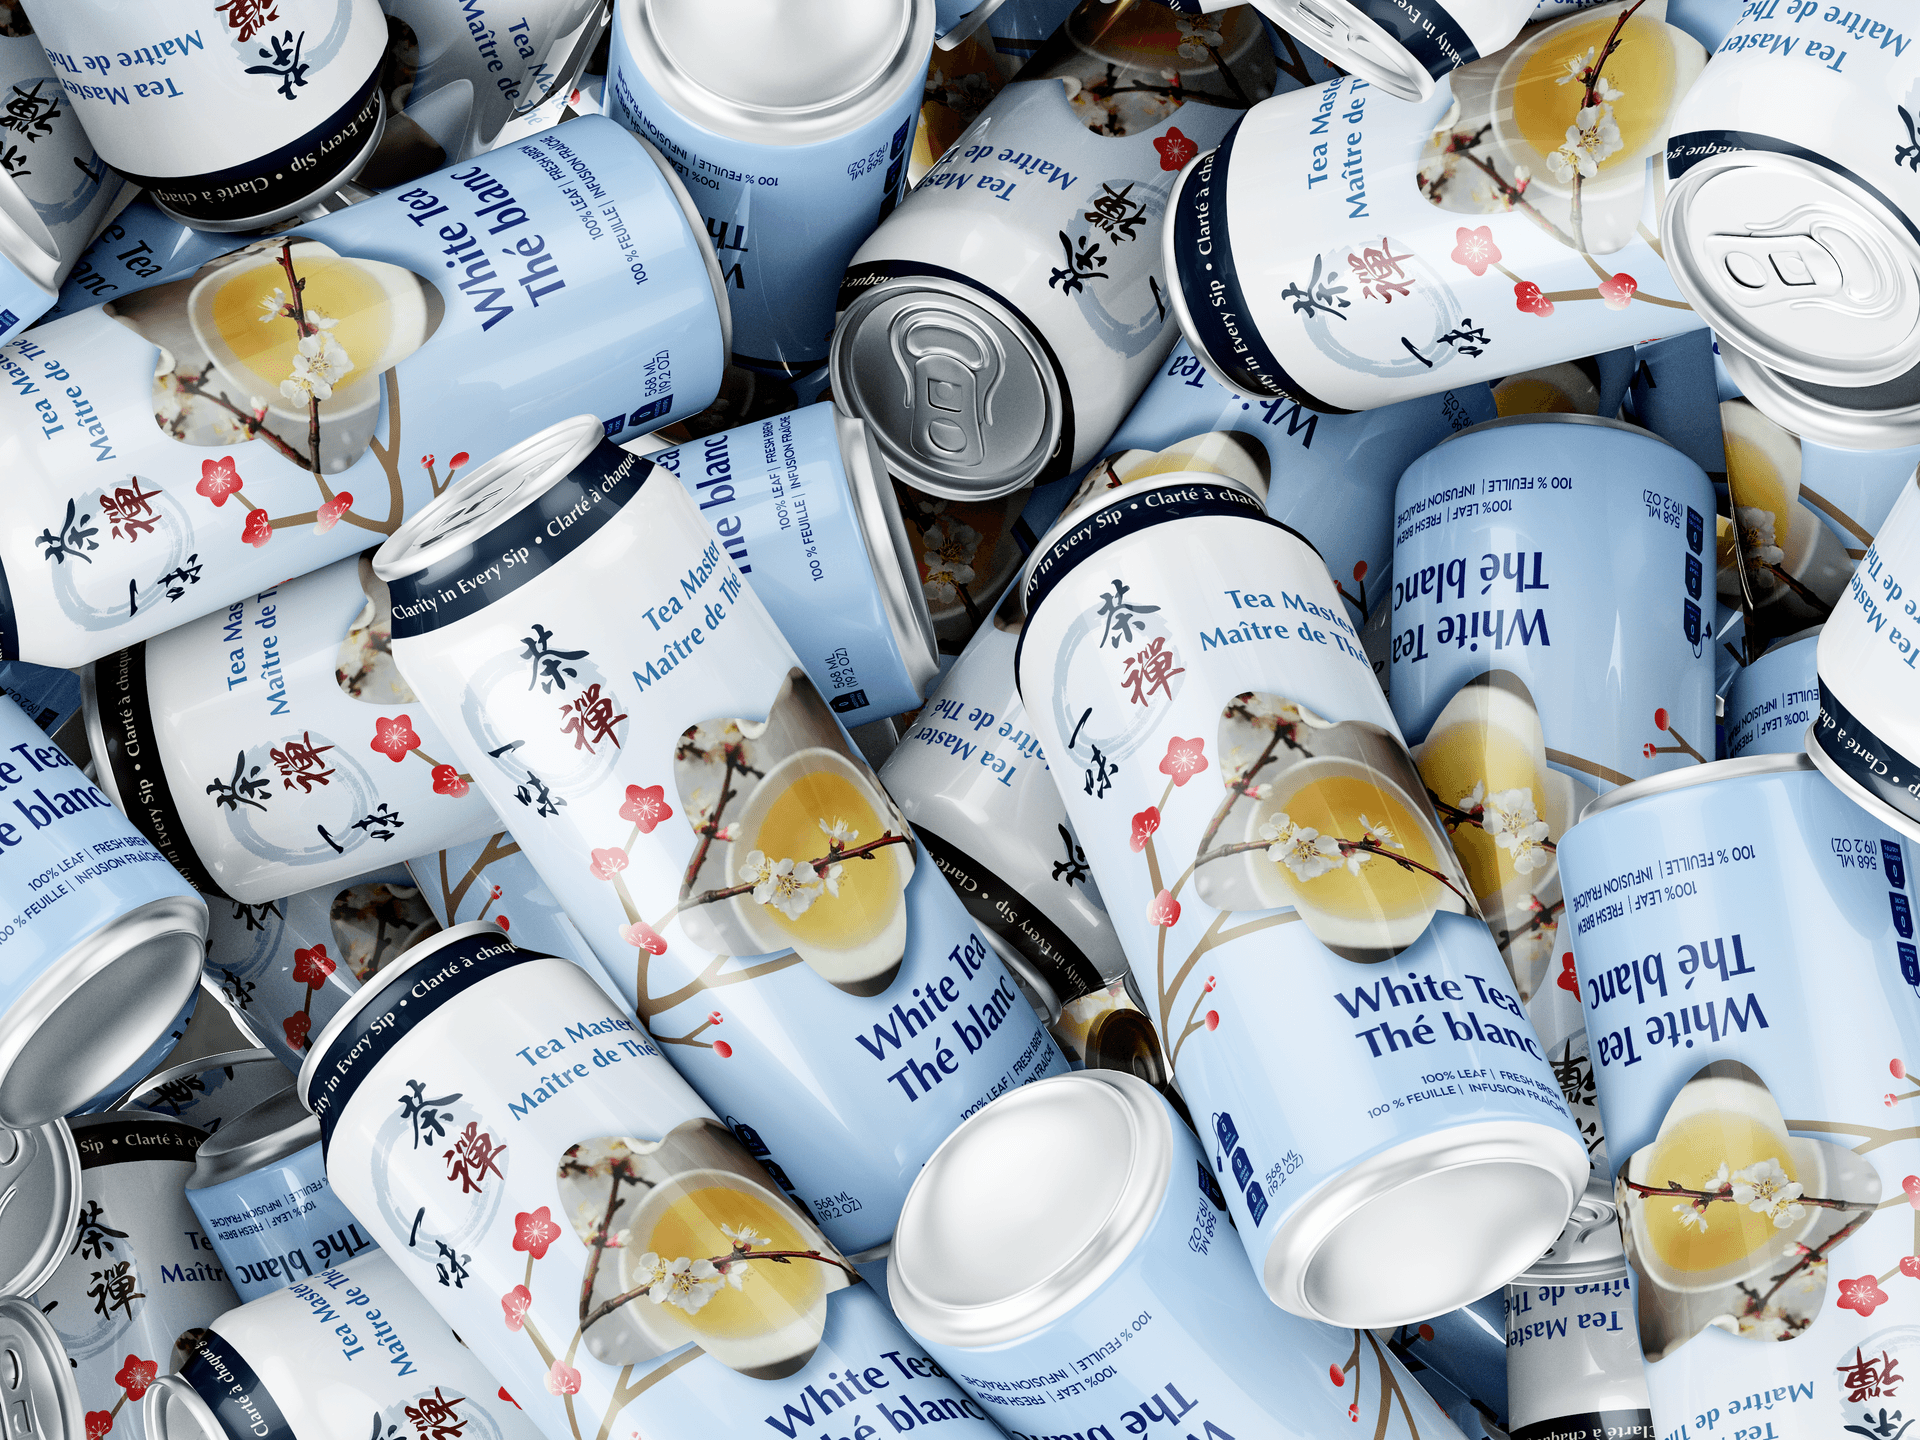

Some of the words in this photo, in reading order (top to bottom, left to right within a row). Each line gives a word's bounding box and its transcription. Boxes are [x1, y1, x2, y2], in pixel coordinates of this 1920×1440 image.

[1737, 0, 1780, 25] Thé
[1787, 0, 1818, 23] de
[119, 29, 205, 67] Maître
[1718, 33, 1800, 56] Master
[1824, 6, 1912, 57] Maître
[46, 47, 82, 75] Thé
[84, 52, 111, 75] de
[1805, 40, 1847, 73] Tea
[63, 78, 130, 106] Master
[133, 77, 184, 99] Tea
[358, 107, 375, 126] in
[1310, 77, 1345, 135] Maste
[1342, 98, 1366, 124] de
[320, 123, 358, 157] Every
[517, 144, 545, 164] BREW
[965, 144, 994, 166] de
[290, 152, 317, 173] Sip
[540, 158, 563, 182] FRESH
[997, 148, 1078, 191] Maître
[1307, 141, 1329, 190] Tea
[1342, 132, 1370, 219] Maître
[216, 177, 270, 202] Clarté
[450, 166, 530, 236] blanc
[562, 189, 587, 211] LEAF
[972, 175, 1017, 202] Tea
[397, 187, 450, 227] Tea
[579, 212, 604, 241] 100%
[1195, 203, 1213, 256] Clarté
[117, 240, 163, 279] Tea
[502, 234, 566, 308] Thé
[439, 222, 514, 332] White
[1209, 280, 1226, 307] Sip
[11, 338, 46, 360] Thé
[1220, 311, 1249, 355] Every
[45, 360, 72, 381] de
[1245, 356, 1260, 373] in
[35, 398, 64, 439] Tea
[66, 385, 116, 462] Maître
[763, 420, 773, 439] BREW
[766, 438, 776, 464] FRESH
[696, 435, 736, 511] blanc
[772, 470, 786, 497] LEAF
[1489, 478, 1534, 492] FEUILLE
[1551, 477, 1573, 489] 100
[776, 497, 791, 530] 100%
[1427, 484, 1476, 509] INFUSION
[392, 596, 438, 621] Clarity
[438, 590, 457, 603] in
[456, 561, 502, 593] Every
[502, 545, 529, 567] Sip
[547, 495, 591, 538] Clarté
[602, 454, 637, 495] chaque
[1039, 559, 1053, 576] in
[1054, 523, 1094, 560] Every
[1095, 510, 1122, 528] Sip
[1145, 487, 1199, 509] Clarté
[641, 597, 684, 632] Tea
[680, 539, 721, 599] Master
[1394, 557, 1466, 612] blanc
[1480, 552, 1549, 596] Thé
[1884, 574, 1903, 601] de
[255, 604, 277, 629] de
[1224, 590, 1276, 610] Tea
[1281, 590, 1355, 638] Master
[1851, 572, 1888, 634] Master
[632, 627, 705, 692] Maître
[704, 601, 726, 632] de
[719, 566, 742, 604] Thé
[1199, 620, 1289, 651] Maître
[1297, 625, 1327, 646] de
[1330, 631, 1370, 669] Thé
[1393, 625, 1428, 663] Tea
[1437, 609, 1551, 652] White
[228, 647, 248, 691] Tea
[261, 636, 290, 716] Maître
[931, 698, 964, 721] Thé
[968, 708, 995, 731] de
[10, 742, 73, 769] Tea
[914, 727, 977, 761] Master
[980, 750, 1017, 787] Tea
[14, 786, 112, 831] blanc
[1832, 837, 1852, 853] OZ)
[1836, 854, 1855, 868] ML
[1855, 839, 1877, 855] (19.2
[28, 868, 59, 891] 100%
[61, 852, 85, 874] LEAF
[93, 838, 123, 855] FRESH
[124, 835, 149, 849] BREW
[1857, 855, 1877, 870] 568
[1635, 887, 1662, 911] LEAF
[1665, 880, 1697, 900] 100%
[1577, 912, 1596, 936] BREW
[1595, 901, 1624, 925] FRESH
[1677, 933, 1755, 990] Thé
[855, 975, 960, 1062] White
[948, 933, 986, 981] Tea
[1334, 972, 1464, 1019] White
[1465, 974, 1525, 1021] Tea
[1587, 952, 1668, 1010] blanc
[1355, 1014, 1436, 1058] Thé
[1442, 1011, 1542, 1062] blanc
[1646, 992, 1770, 1049] White
[515, 1038, 566, 1068] Tea
[564, 1015, 635, 1045] Master
[887, 1036, 959, 1103] Thé
[952, 975, 1016, 1055] blanc
[1598, 1026, 1642, 1067] Tea
[507, 1061, 590, 1121] Maître
[593, 1047, 622, 1070] de
[618, 1039, 659, 1057] Thé
[1420, 1070, 1455, 1084] 100%
[1457, 1069, 1487, 1079] LEAF
[1499, 1070, 1534, 1087] FRESH
[1535, 1078, 1561, 1100] BREW
[1367, 1103, 1390, 1119] 100
[1406, 1085, 1457, 1106] FEUILLE
[1468, 1083, 1525, 1098] INFUSION
[80, 1138, 104, 1154] Sip
[125, 1133, 171, 1146] Clarté
[1265, 1162, 1282, 1184] 568
[1281, 1149, 1298, 1166] ML
[1267, 1172, 1286, 1197] (19.2
[1287, 1154, 1304, 1174] OZ)
[814, 1197, 834, 1210] 568
[834, 1191, 853, 1204] ML
[818, 1208, 842, 1221] (19.2
[842, 1199, 862, 1214] OZ)
[321, 1268, 350, 1288] Thé
[289, 1283, 341, 1325] Master
[346, 1286, 369, 1306] de
[1577, 1310, 1623, 1331] Tea
[335, 1324, 365, 1361] Tea
[365, 1308, 418, 1377] Maître
[764, 1360, 890, 1440] White
[879, 1351, 944, 1380] Tea
[876, 1394, 985, 1436] blanc
